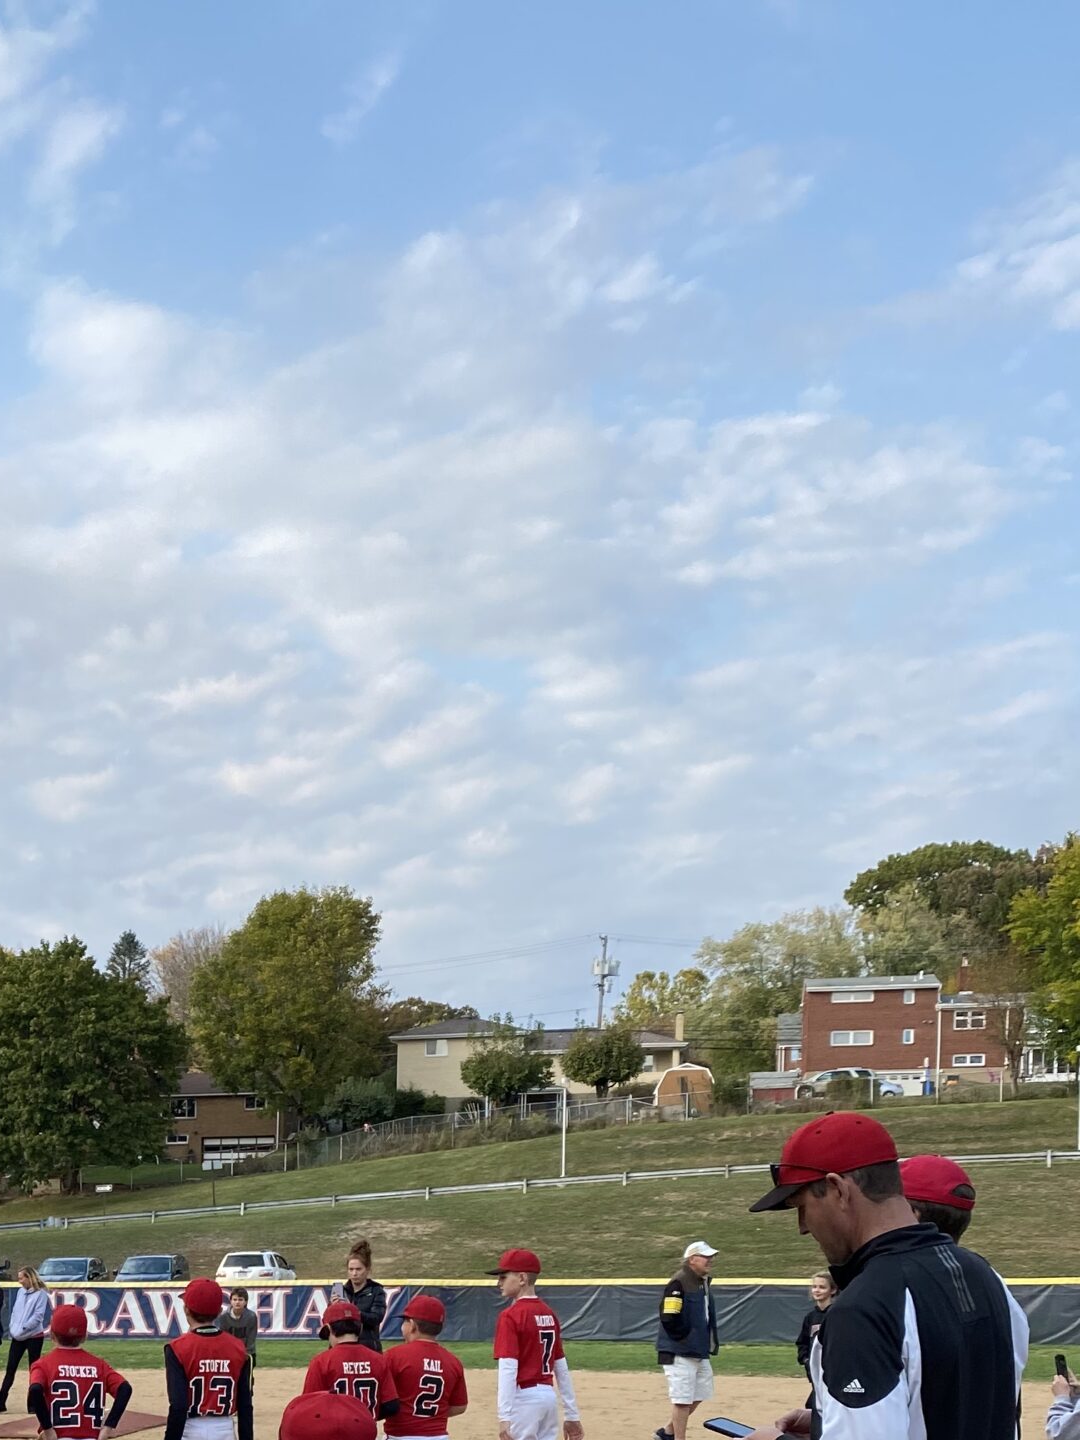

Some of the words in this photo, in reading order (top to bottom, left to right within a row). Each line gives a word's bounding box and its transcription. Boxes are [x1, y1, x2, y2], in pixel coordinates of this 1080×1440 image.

[46, 1288, 400, 1336] RAWHA
[58, 1364, 99, 1379] STOCKER
[198, 1359, 231, 1373] STOFIK
[342, 1360, 372, 1375] REYES
[423, 1358, 443, 1374] KAIL
[538, 1329, 556, 1375] 7
[50, 1379, 105, 1429] 24
[187, 1375, 236, 1418] 13
[412, 1374, 445, 1418] 2
